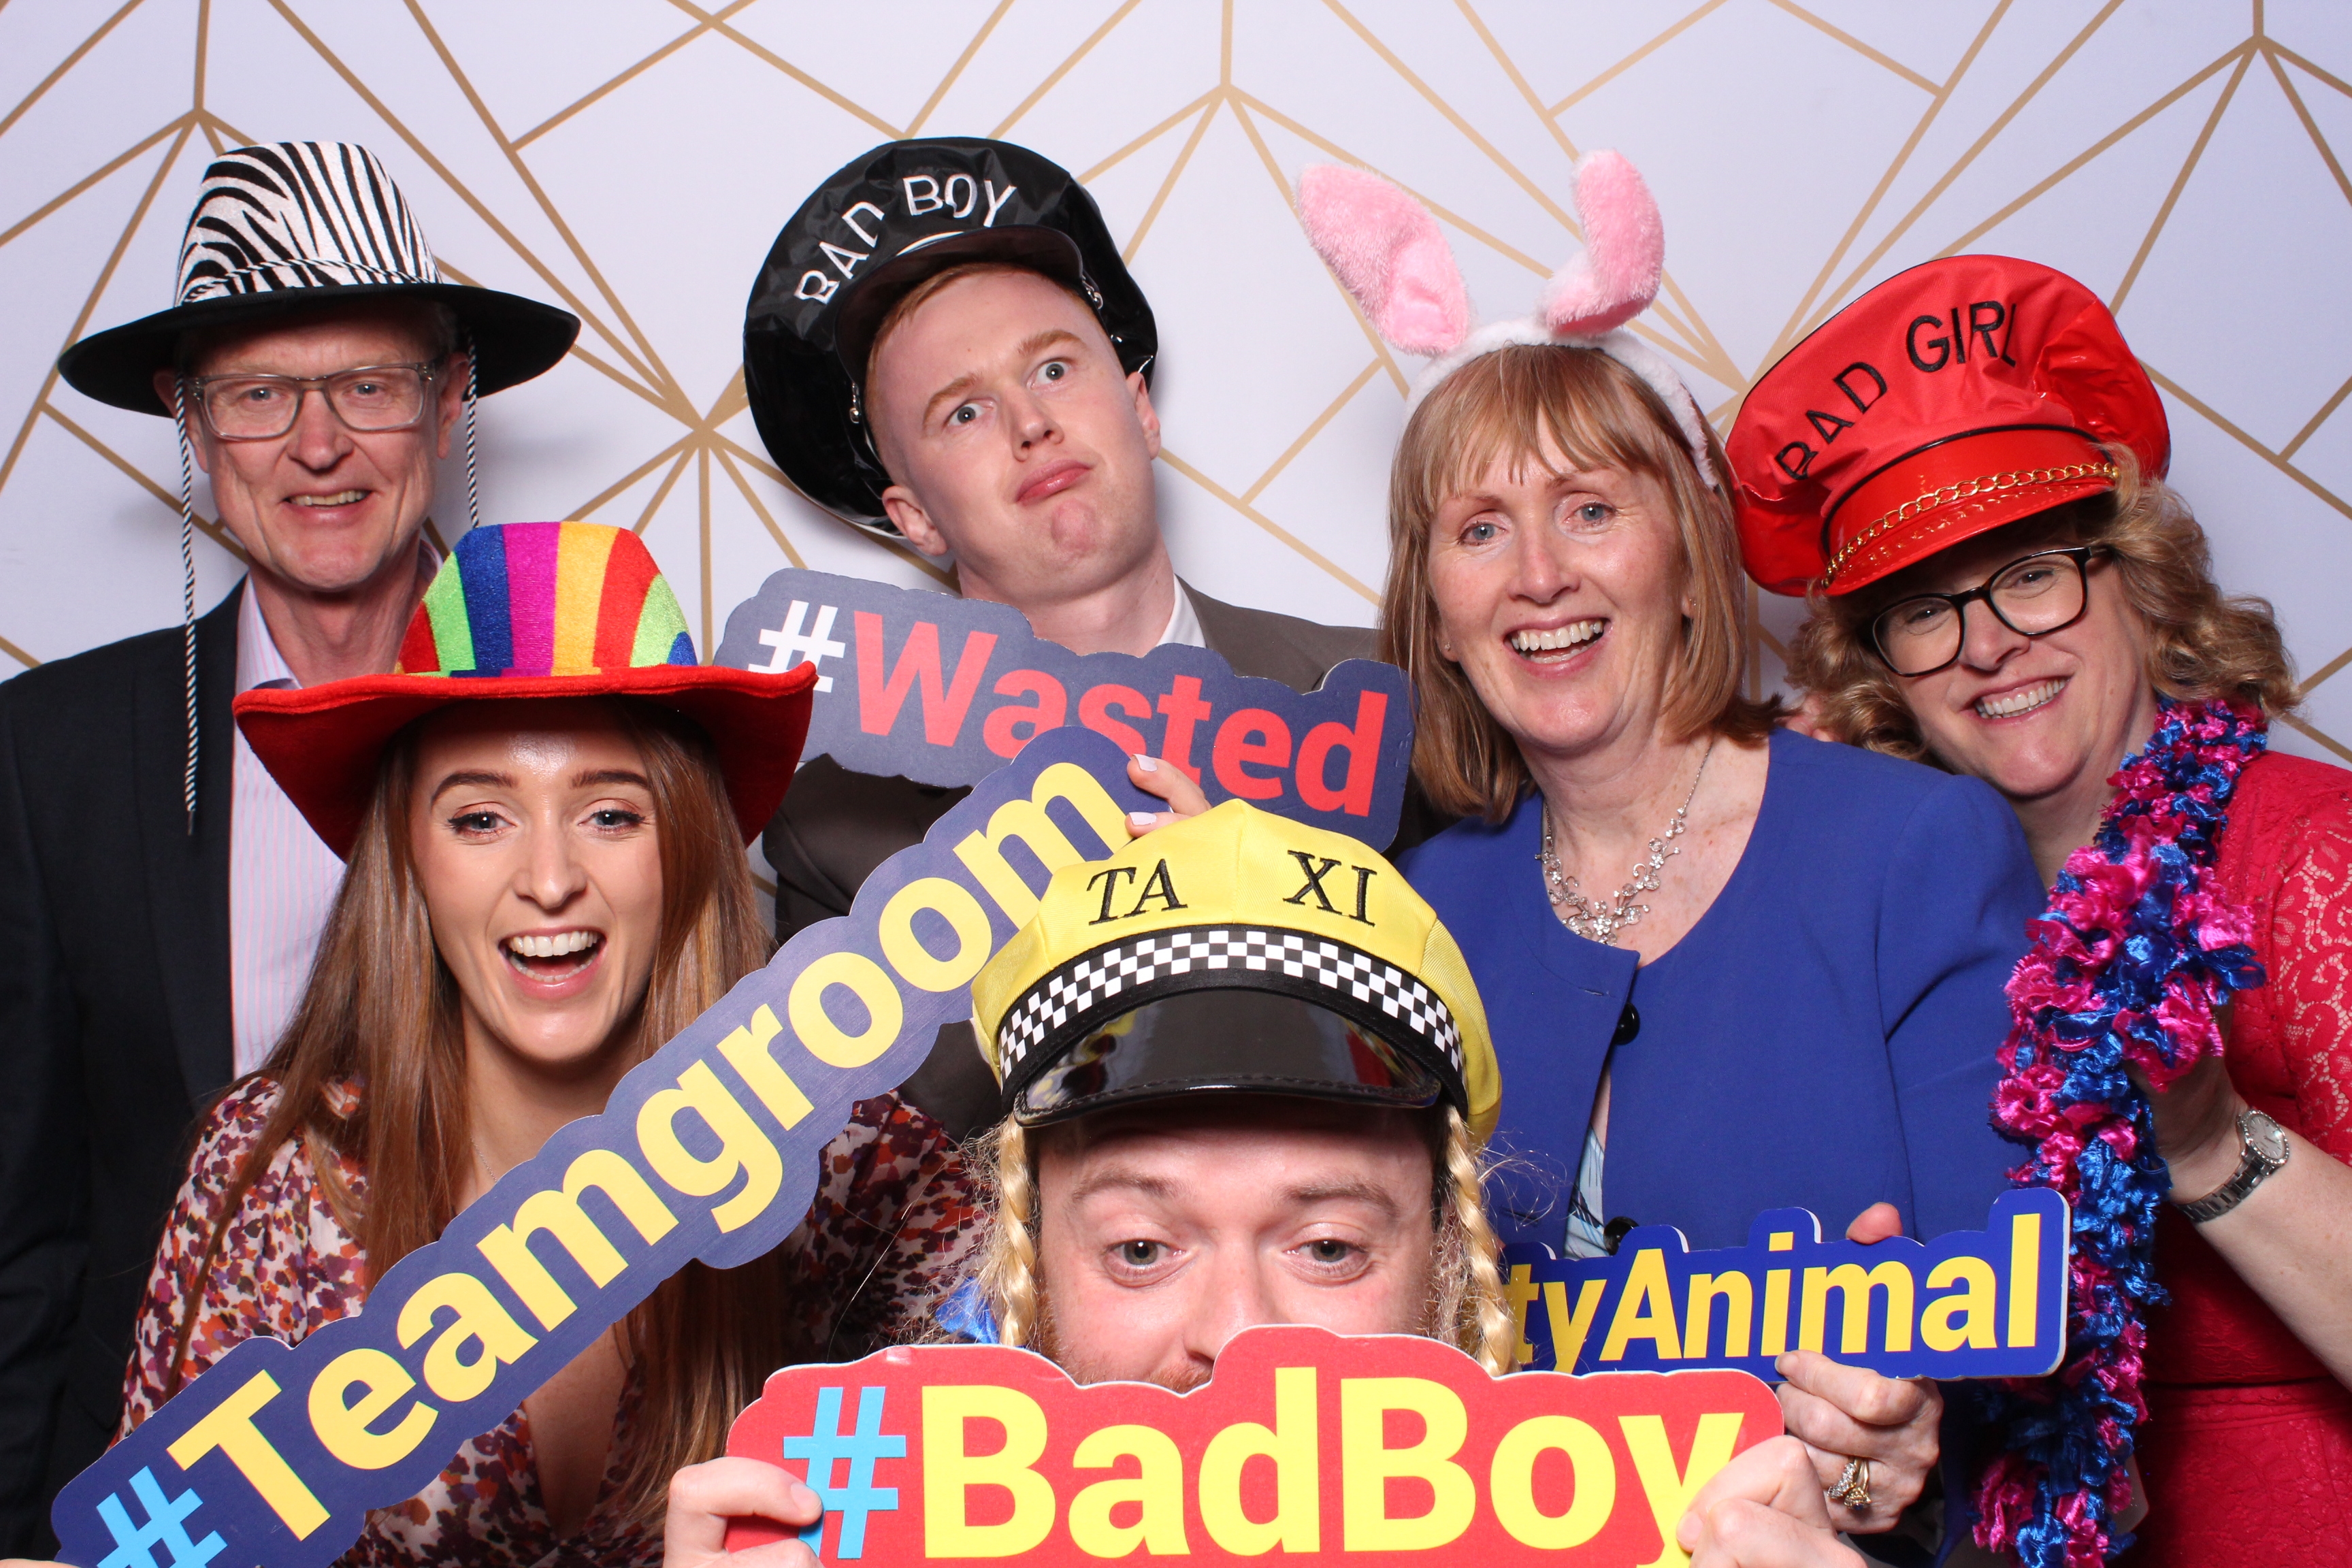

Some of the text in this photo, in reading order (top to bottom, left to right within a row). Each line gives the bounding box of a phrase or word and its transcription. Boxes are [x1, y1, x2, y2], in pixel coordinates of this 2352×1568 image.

[794, 173, 1017, 305] BAD BOY
[1774, 300, 2017, 480] BAD GIRL
[747, 600, 1388, 817] #Wasted
[97, 761, 1130, 1568] #Teamgroom
[783, 1367, 1746, 1568] #BadBoy
